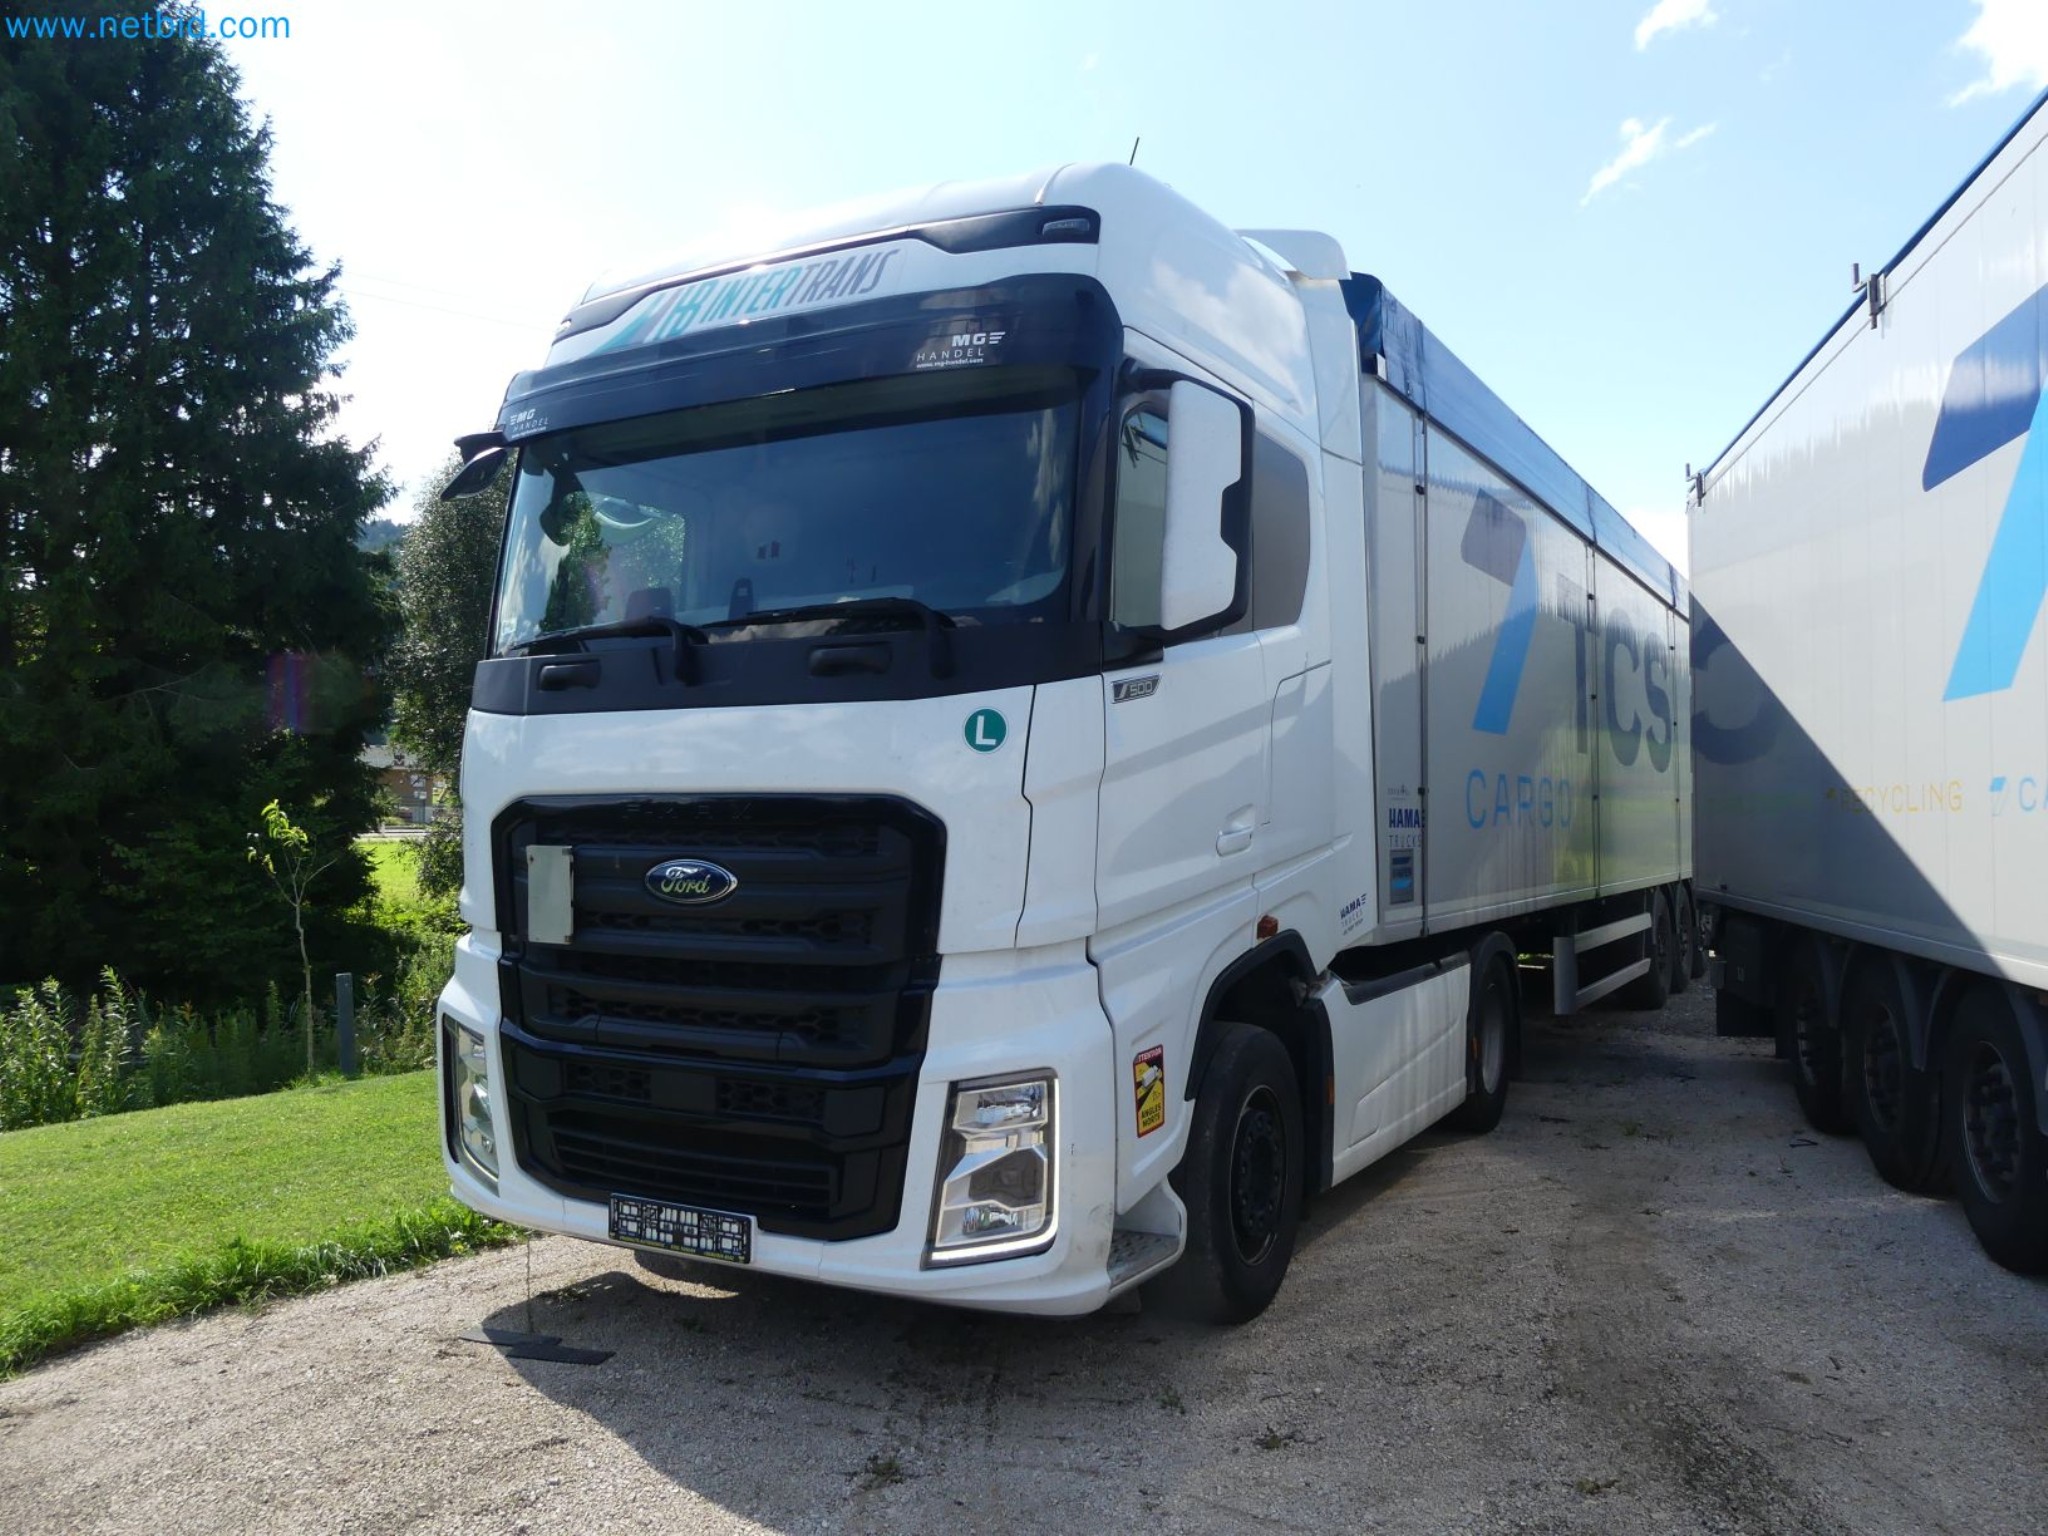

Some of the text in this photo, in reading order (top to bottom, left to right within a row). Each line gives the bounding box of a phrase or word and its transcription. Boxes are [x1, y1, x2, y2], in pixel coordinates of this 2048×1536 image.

[700, 249, 899, 323] INTERTRANS
[916, 347, 985, 362] HANDEL
[1130, 681, 1153, 697] 500
[975, 715, 997, 746] L
[1465, 768, 1573, 829] CARGO
[1841, 779, 1964, 815] RECYCLING
[1389, 808, 1421, 829] HAMA
[660, 866, 712, 894] Ford
